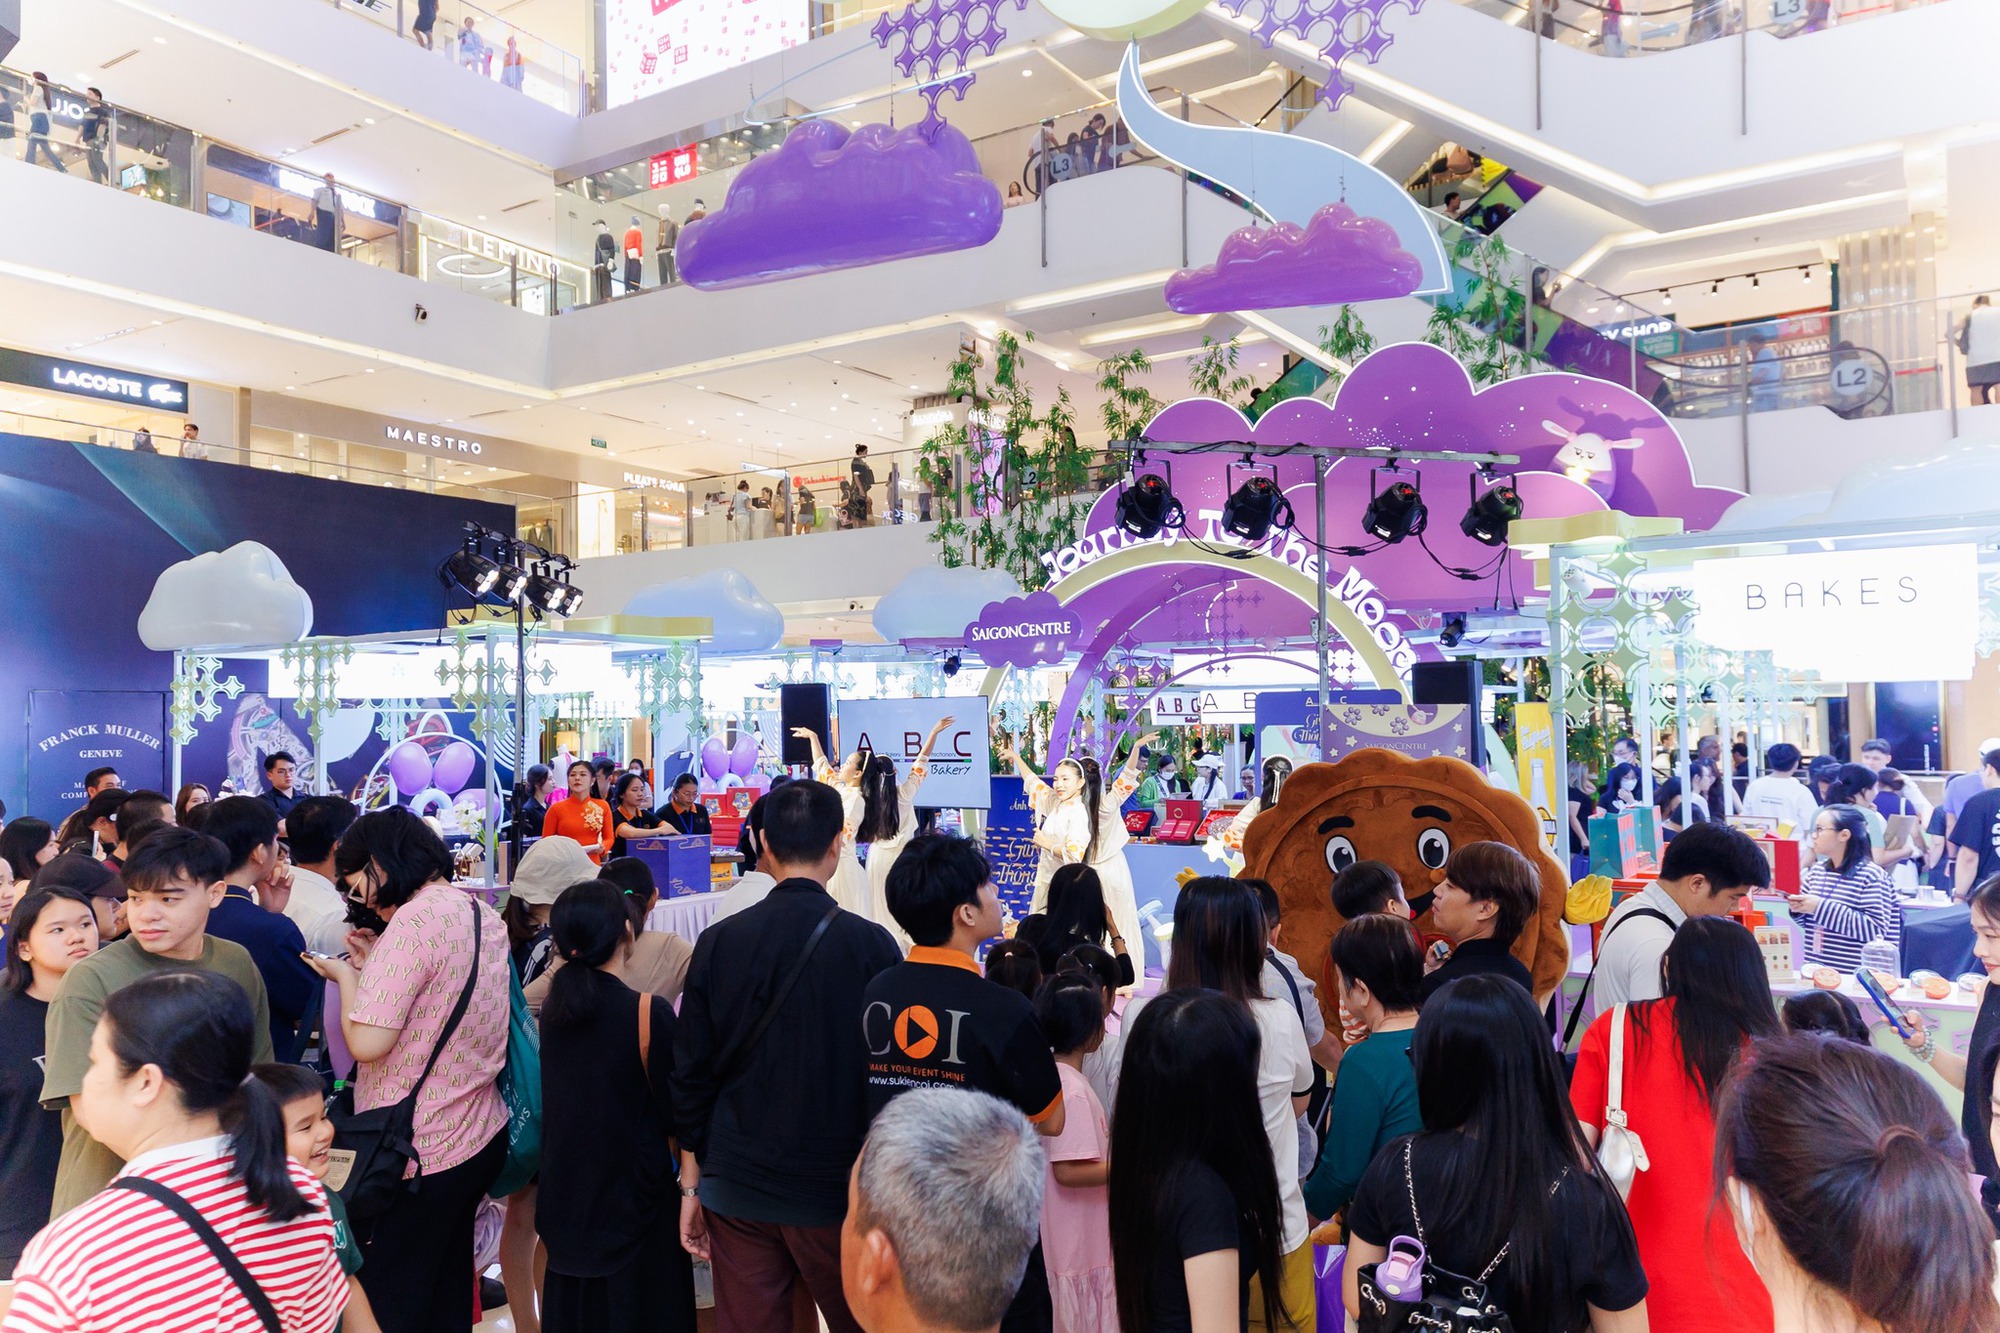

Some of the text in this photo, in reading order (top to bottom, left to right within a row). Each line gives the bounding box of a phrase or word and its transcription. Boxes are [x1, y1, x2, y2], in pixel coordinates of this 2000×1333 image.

[1053, 158, 1070, 174] L3
[53, 367, 142, 398] LACOSTE
[1837, 368, 1867, 388] L2
[386, 426, 482, 455] MAESTRO
[1747, 576, 1917, 610] BAKES
[39, 724, 160, 752] FRANCK MULLER
[79, 749, 123, 758] GENEVE
[931, 764, 971, 776] Bakery
[862, 1001, 971, 1065] COI
[869, 1063, 966, 1082] MAKE YOUR EVENT SHINE
